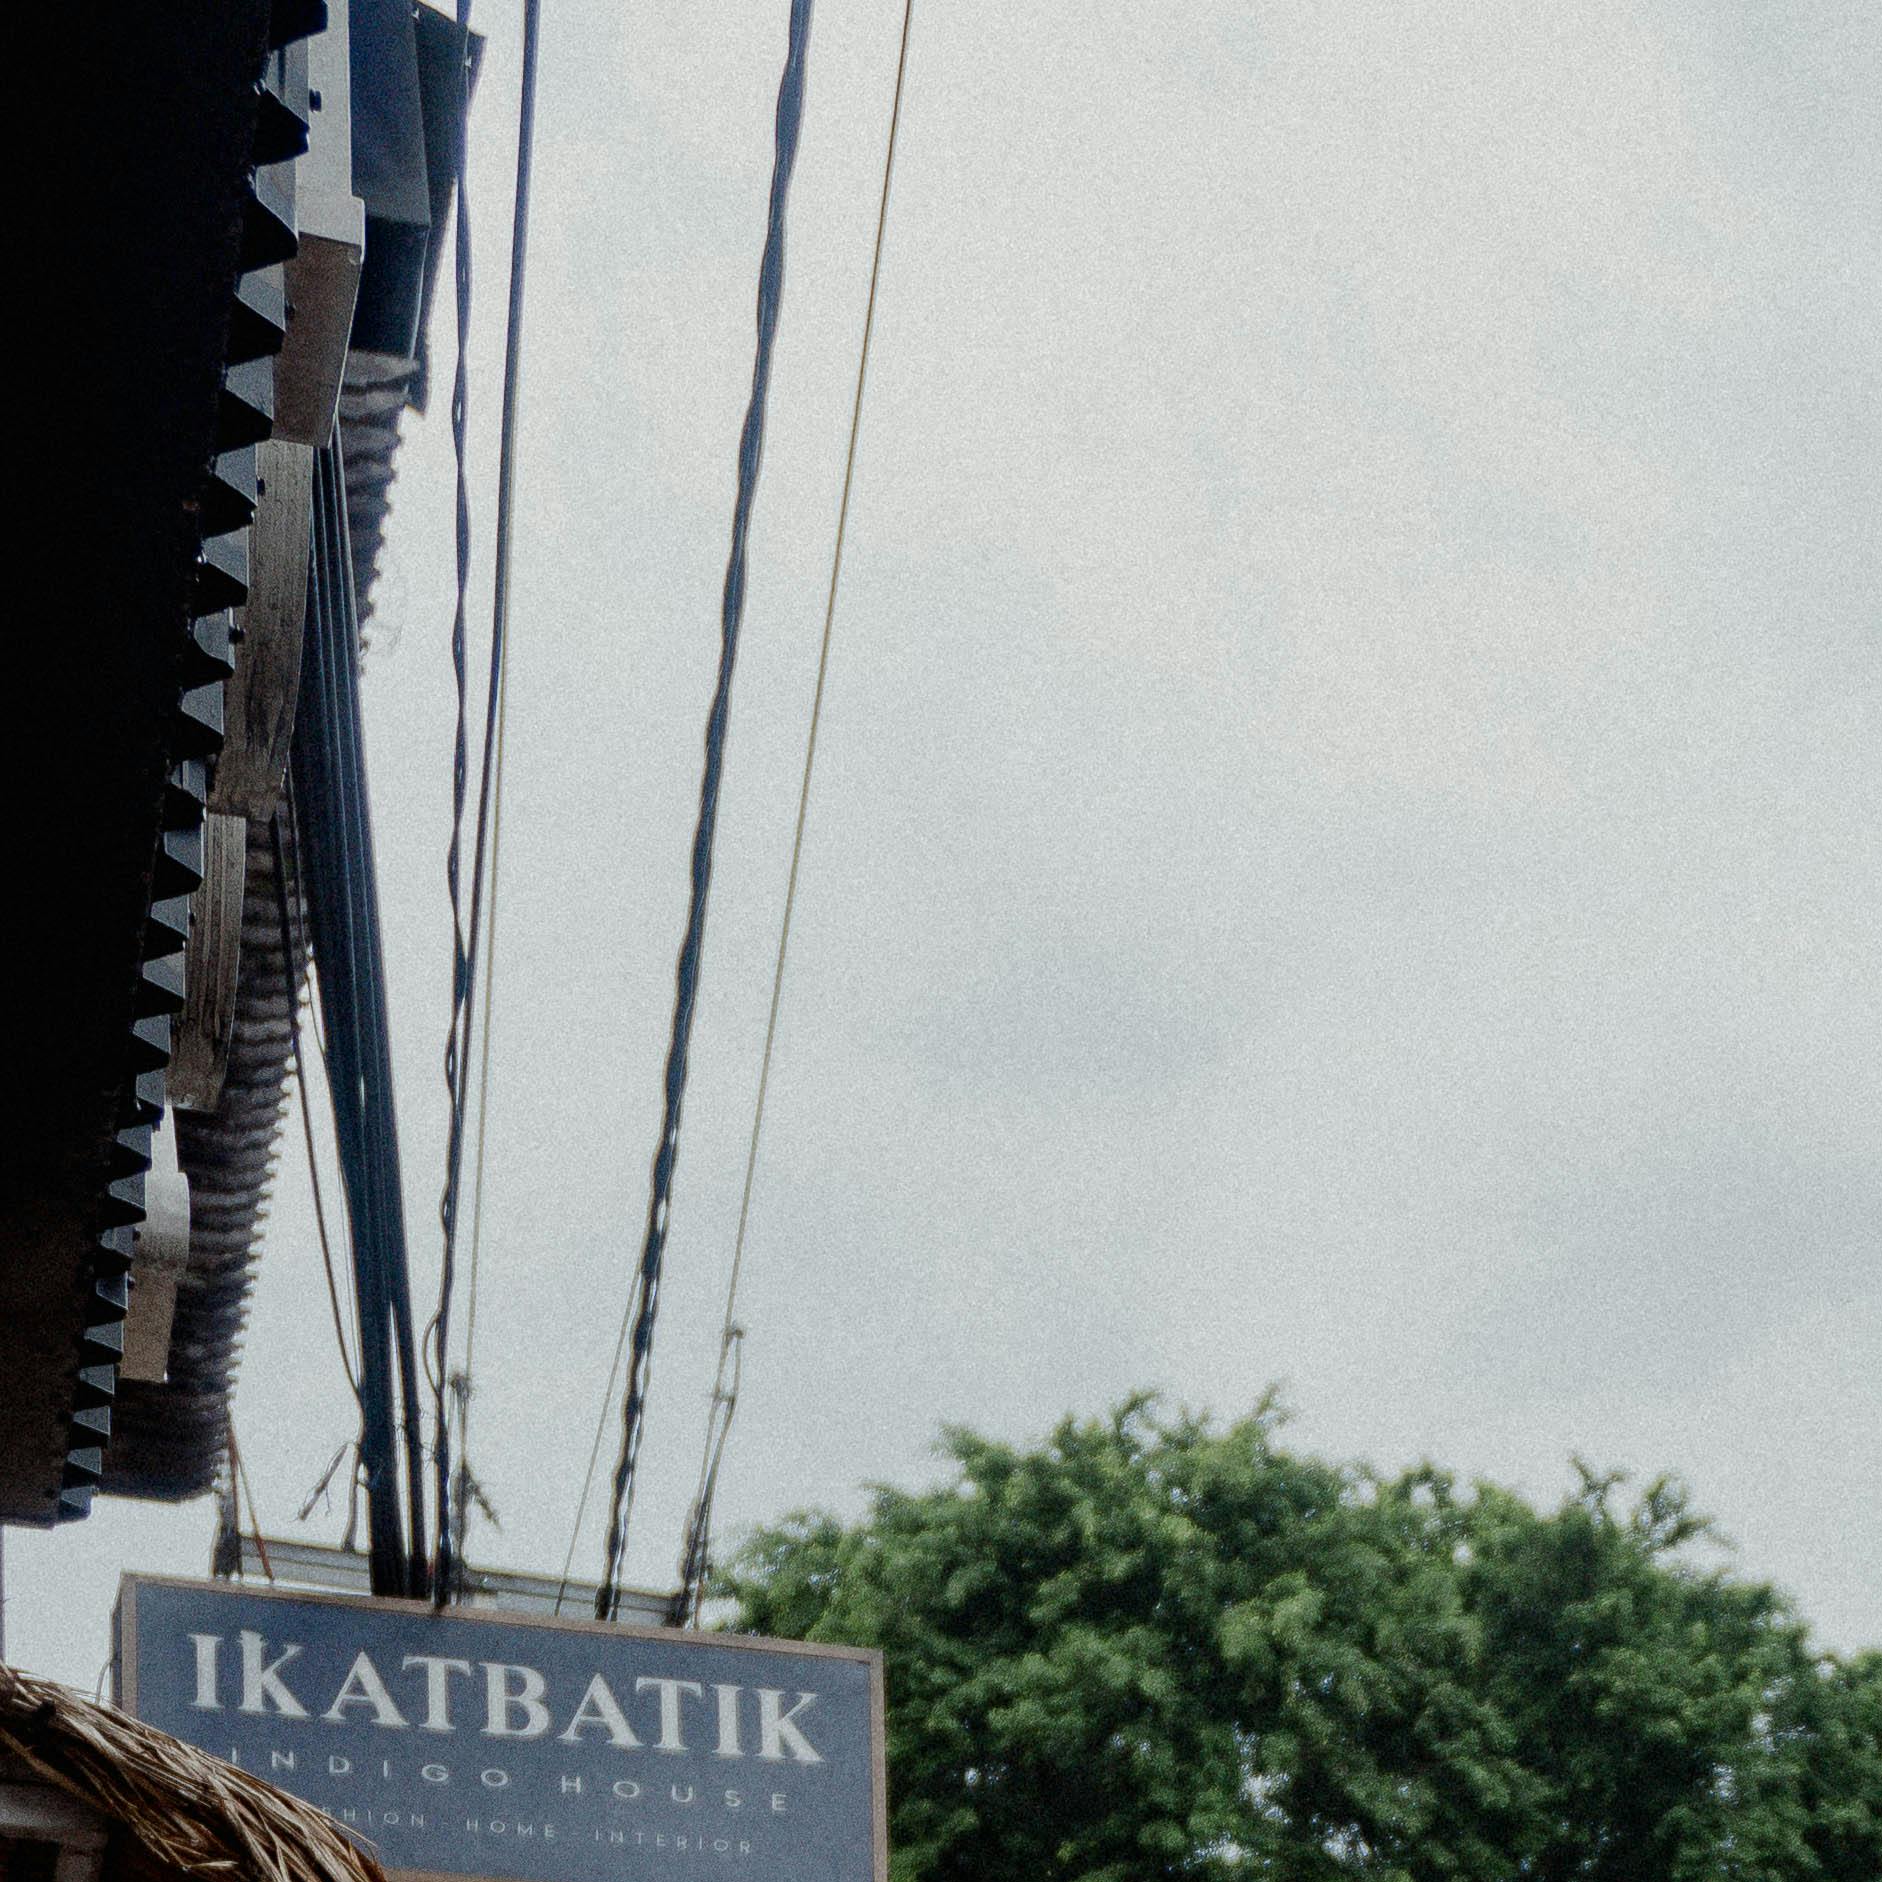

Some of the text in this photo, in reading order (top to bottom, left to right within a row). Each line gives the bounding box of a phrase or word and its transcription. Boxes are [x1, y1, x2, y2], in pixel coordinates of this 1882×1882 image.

[187, 1630, 825, 1764] IKATBATIK
[231, 1747, 788, 1812] INDIGO HOUSE
[466, 1819, 556, 1840] HOME
[594, 1829, 753, 1854] INTERIOR
